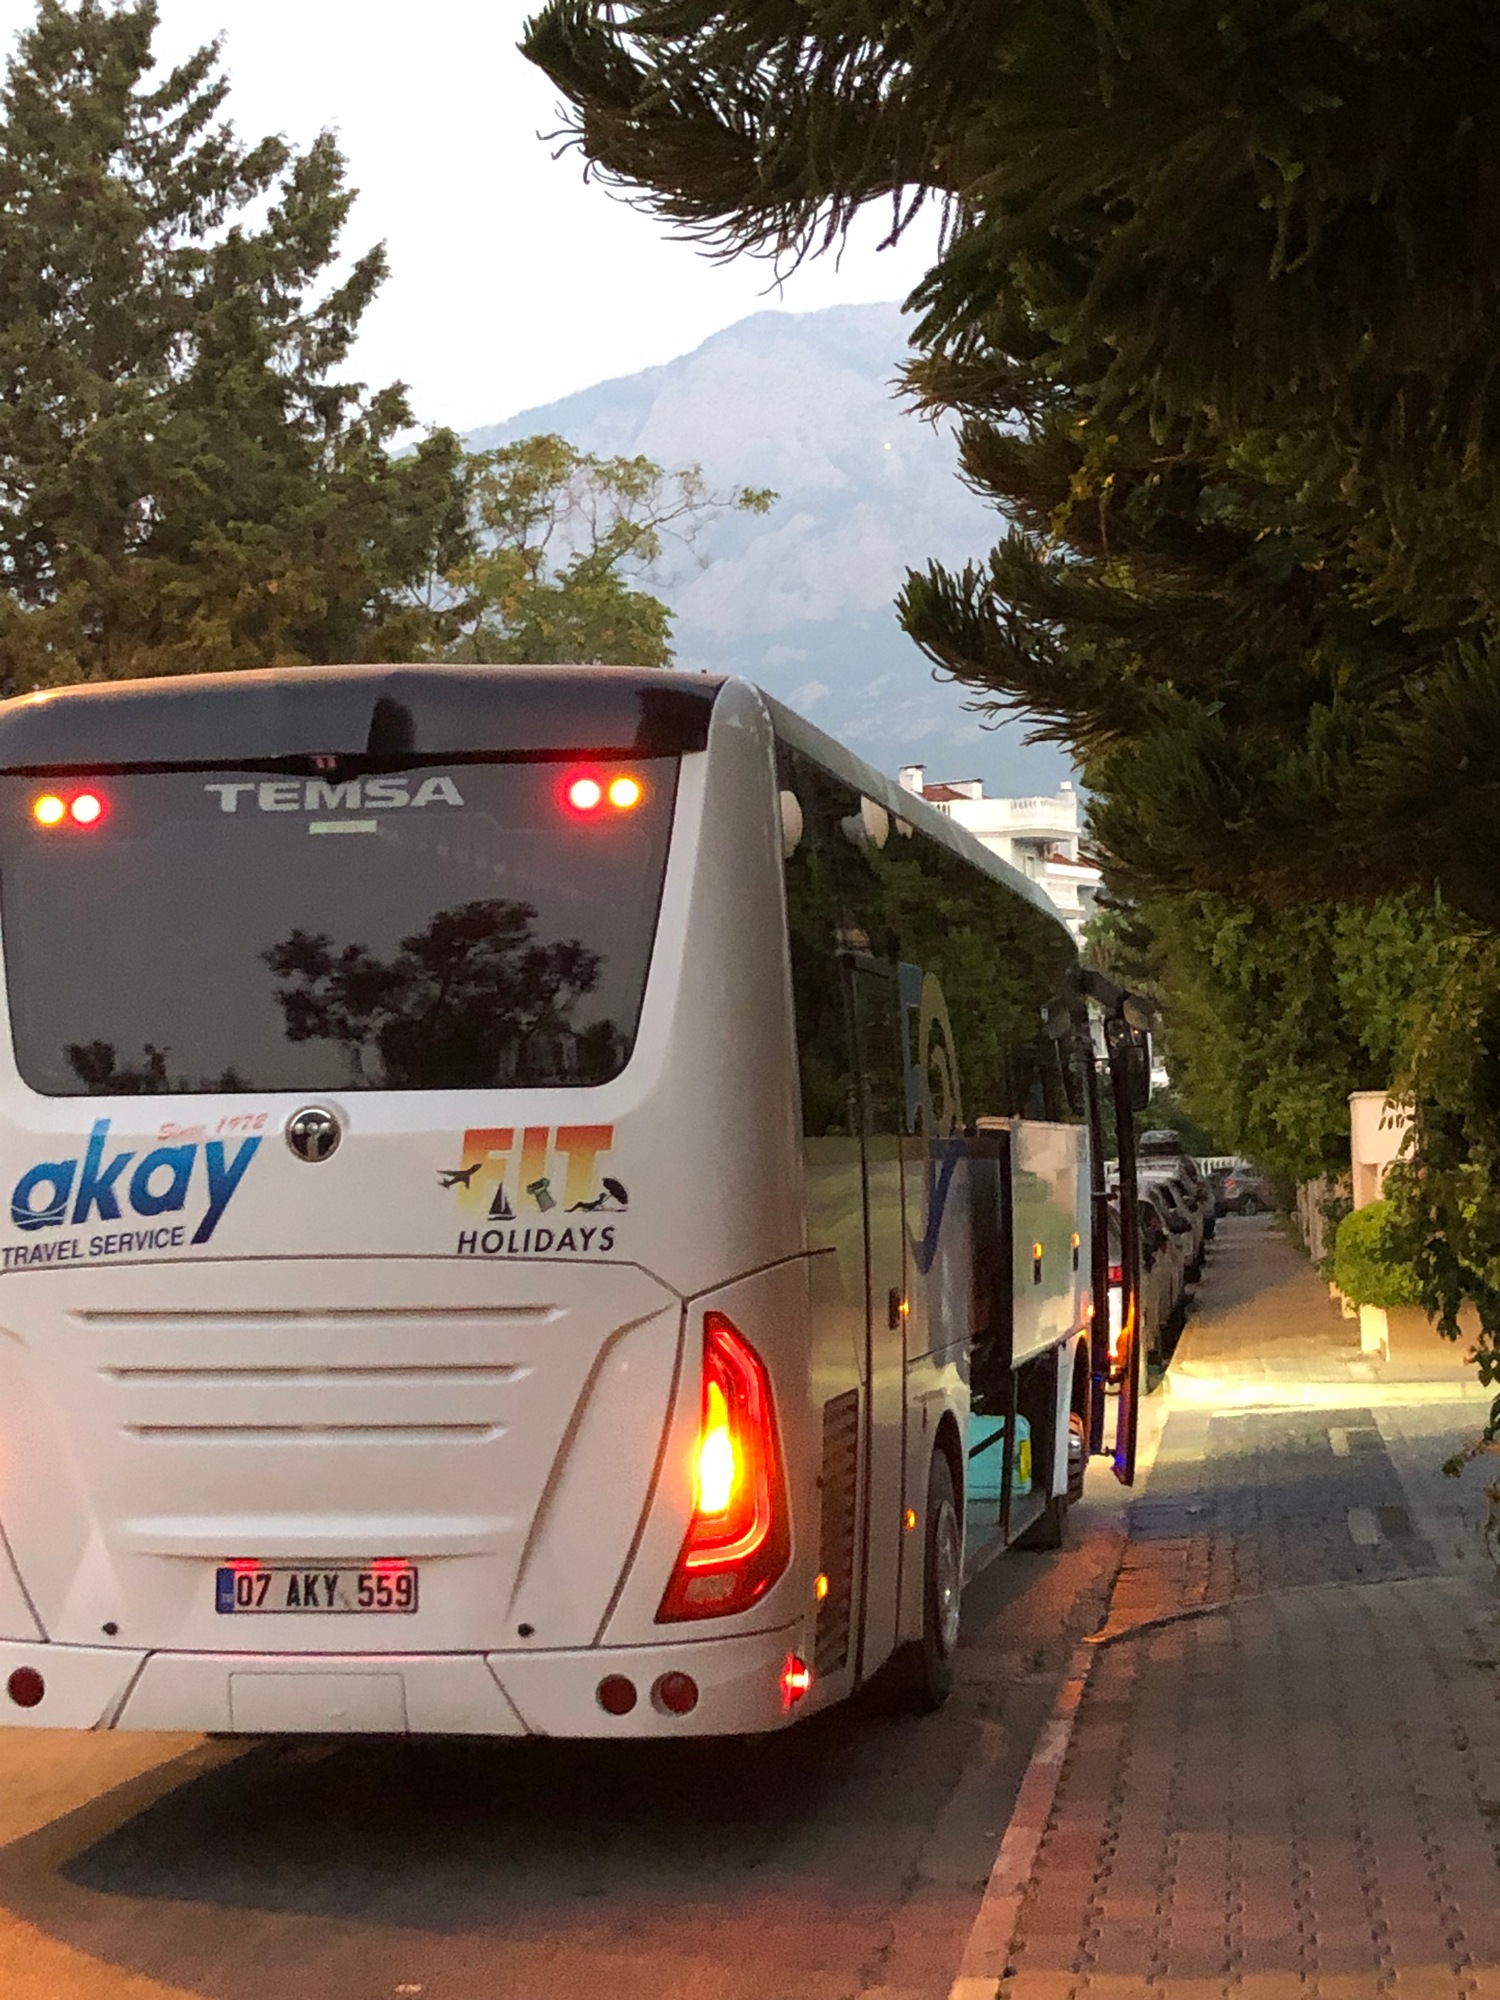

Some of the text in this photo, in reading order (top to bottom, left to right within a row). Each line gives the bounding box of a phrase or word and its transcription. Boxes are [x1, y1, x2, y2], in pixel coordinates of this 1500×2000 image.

[204, 776, 465, 813] TEMSA
[11, 1118, 263, 1245] akay
[456, 1125, 615, 1213] FIT
[2, 1226, 186, 1267] TRAVEL SERVICE
[457, 1226, 615, 1254] HOLIDAYS
[237, 1574, 412, 1607] 07 AKY 559
